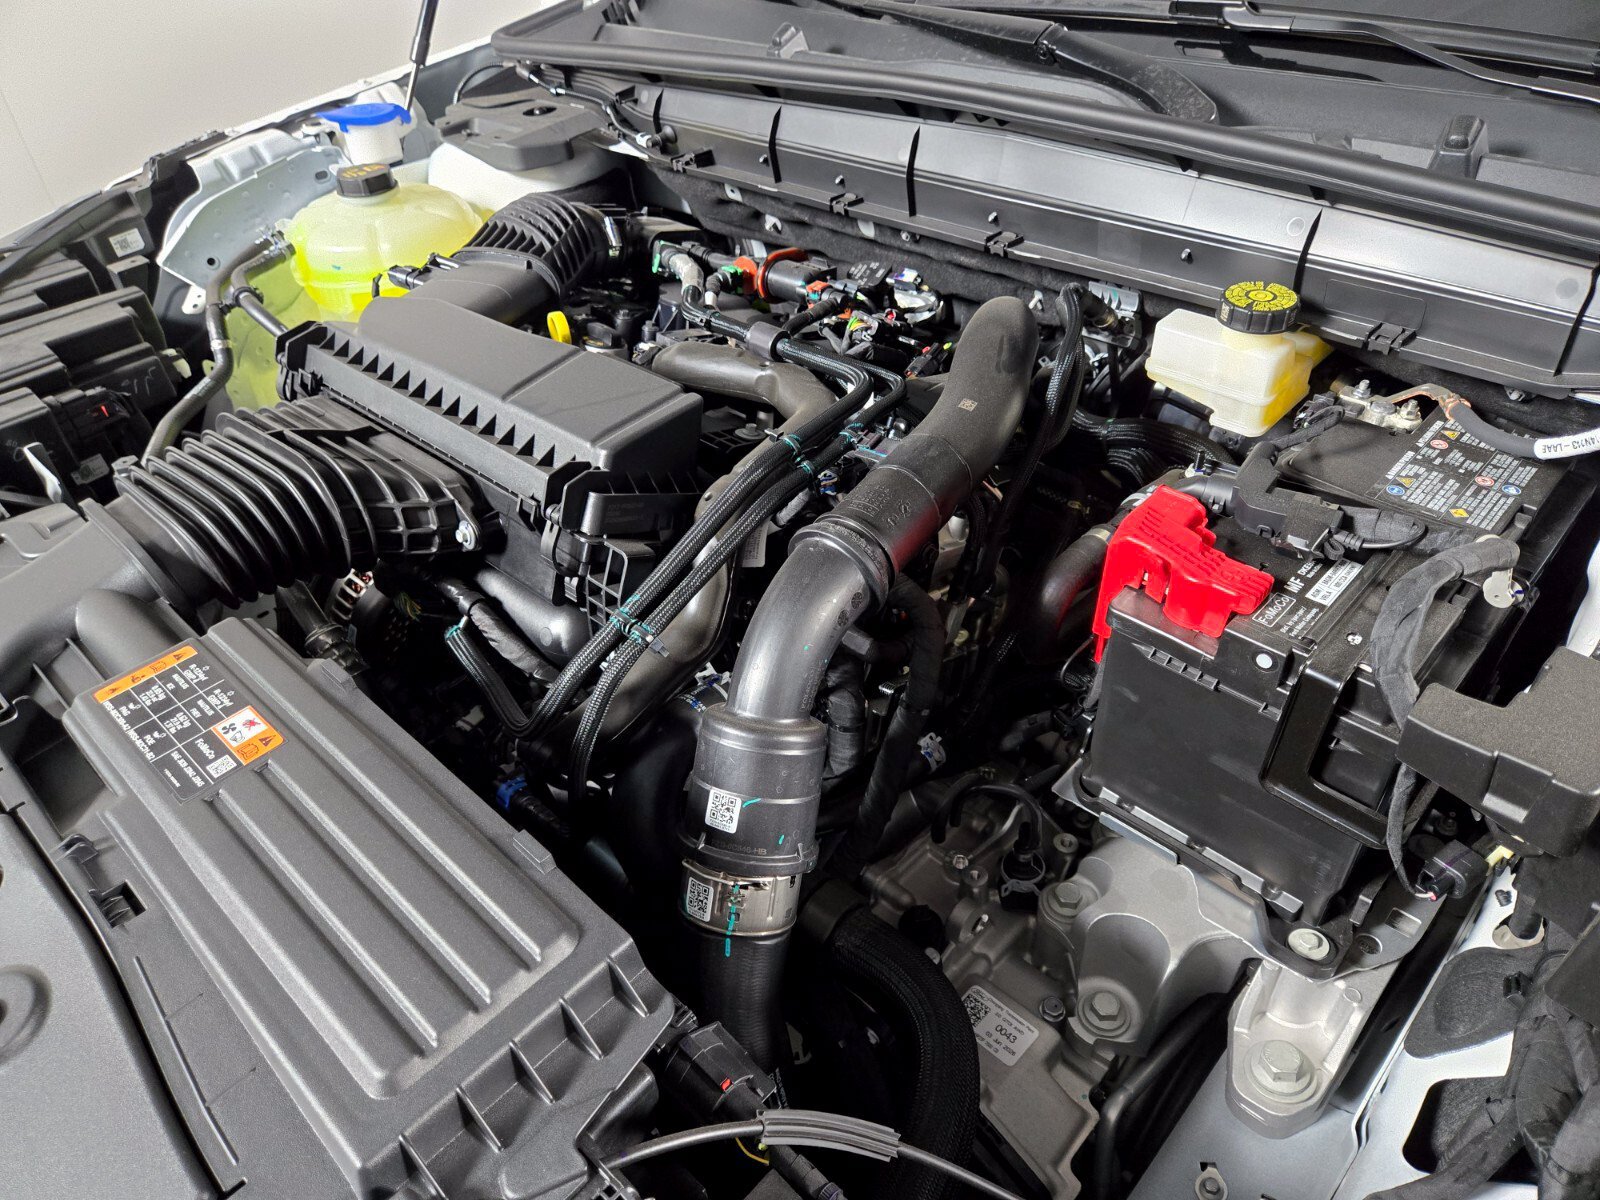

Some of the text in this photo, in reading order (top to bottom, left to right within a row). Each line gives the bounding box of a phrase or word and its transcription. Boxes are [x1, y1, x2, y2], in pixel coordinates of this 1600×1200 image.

[1283, 576, 1306, 593] MF
[1257, 594, 1290, 624] FoMoCo
[193, 737, 217, 760] FoMoCo
[992, 1037, 1003, 1046] Jun
[994, 1023, 1018, 1044] 0043
